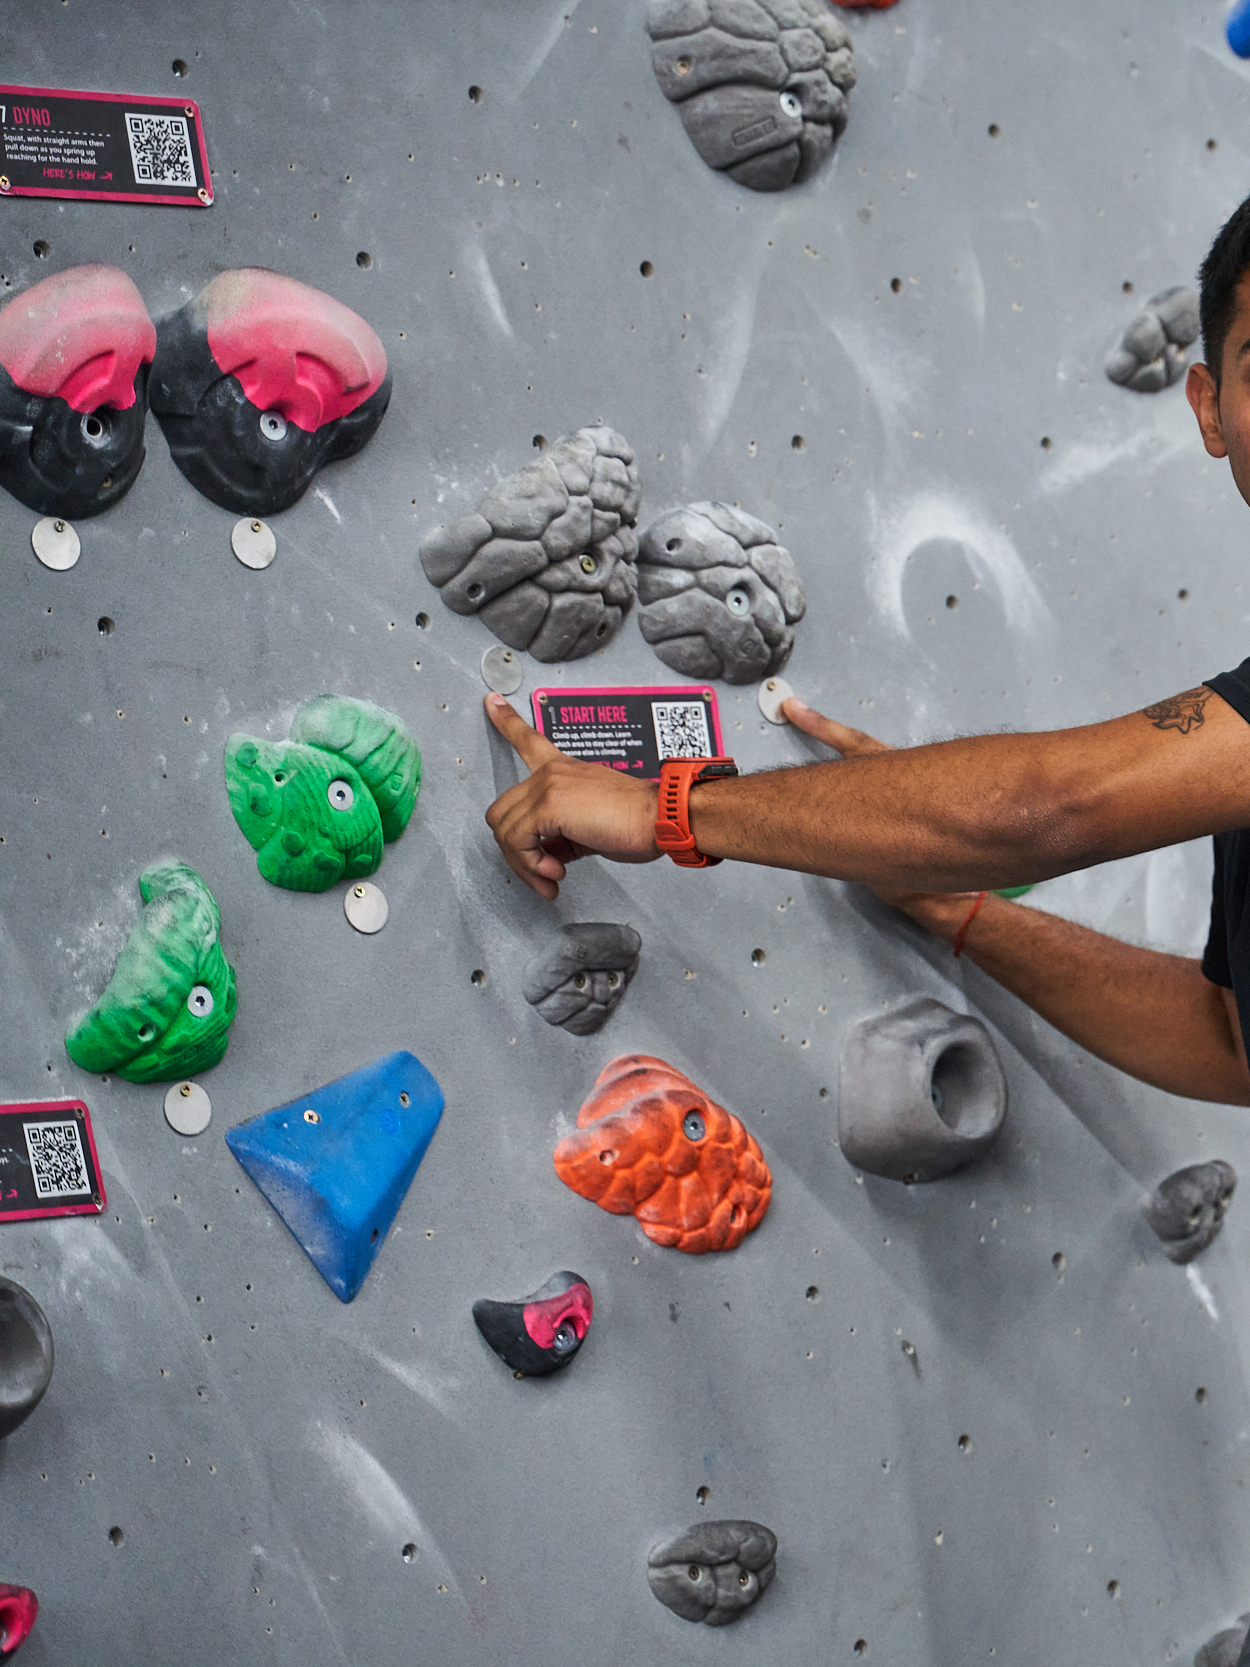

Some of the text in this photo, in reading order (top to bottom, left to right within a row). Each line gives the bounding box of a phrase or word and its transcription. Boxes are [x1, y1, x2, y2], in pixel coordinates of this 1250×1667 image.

[13, 106, 51, 126] DYNO
[3, 133, 26, 143] Squat,
[27, 135, 41, 143] with
[43, 136, 70, 146] straight
[89, 139, 105, 147] then
[4, 143, 18, 152] pull
[19, 144, 39, 152] down
[63, 147, 85, 157] spring
[86, 149, 96, 157] up
[6, 153, 37, 163] reaching
[49, 154, 60, 162] the
[61, 156, 80, 164] hand
[80, 156, 98, 165] hold.
[42, 167, 96, 180] HERE'S HOW
[560, 706, 595, 724] START
[597, 705, 628, 723] HERE
[552, 731, 570, 740] Climb
[580, 731, 597, 739] climb
[585, 740, 592, 748] to
[592, 740, 605, 748] stay
[619, 739, 627, 747] of
[627, 739, 643, 747] when
